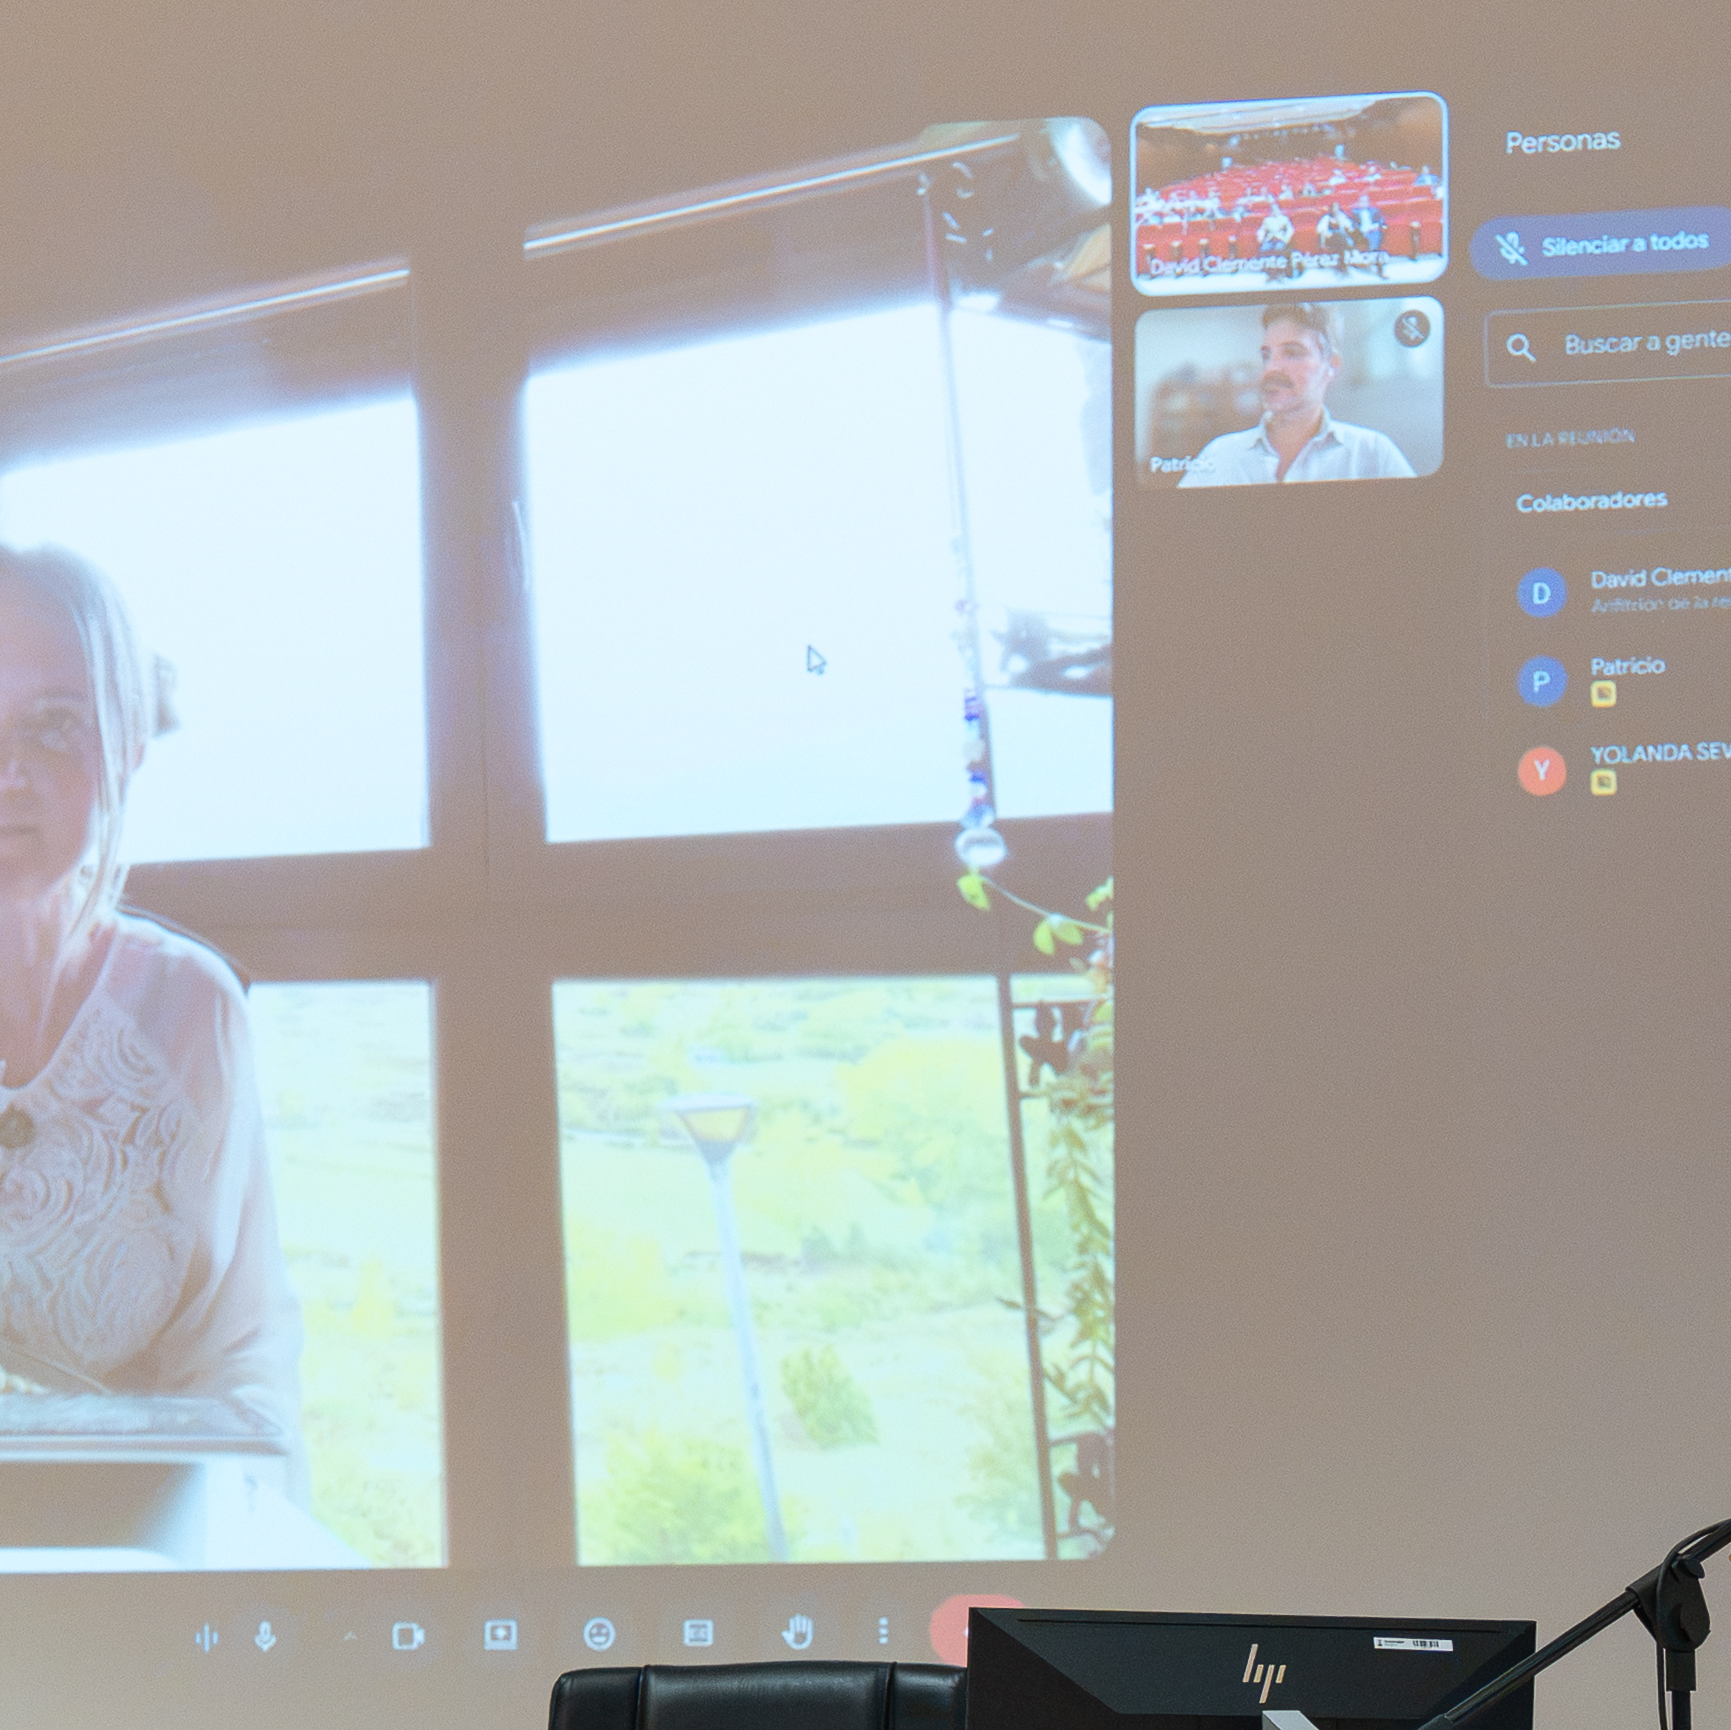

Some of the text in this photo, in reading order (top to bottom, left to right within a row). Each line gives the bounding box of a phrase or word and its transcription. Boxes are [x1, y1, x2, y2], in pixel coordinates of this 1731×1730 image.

[1505, 129, 1622, 154] Personas
[1542, 230, 1710, 258] Silenciar a todos
[1150, 257, 1200, 275] David
[1202, 255, 1288, 274] Clemente
[1565, 333, 1642, 357] Buscar
[1646, 336, 1661, 352] a
[1516, 490, 1669, 513] Colaboradores
[1591, 568, 1647, 588] David
[1532, 583, 1551, 605] D
[1591, 655, 1667, 678] Patricio
[1533, 671, 1551, 694] P
[1591, 743, 1693, 766] YOLANDA
[1533, 759, 1551, 782] Y
[1243, 1643, 1287, 1704] hp
